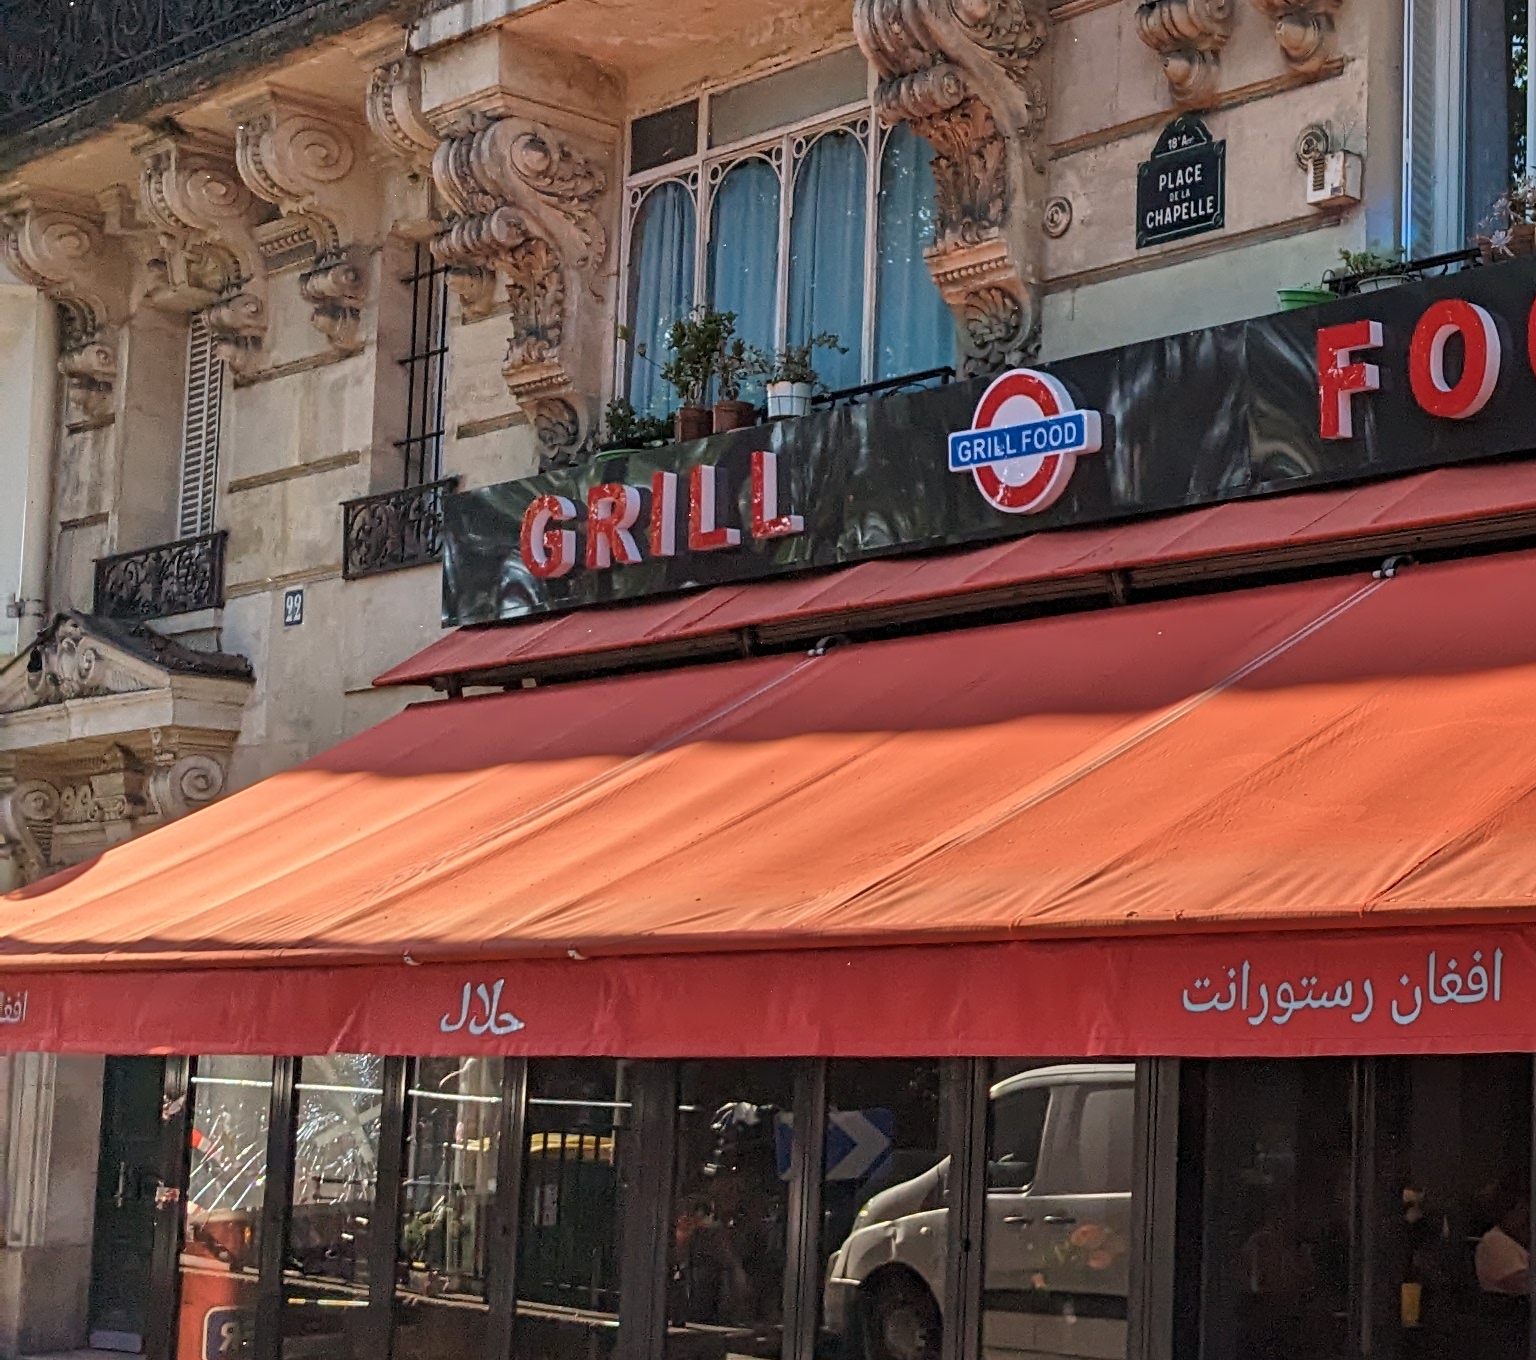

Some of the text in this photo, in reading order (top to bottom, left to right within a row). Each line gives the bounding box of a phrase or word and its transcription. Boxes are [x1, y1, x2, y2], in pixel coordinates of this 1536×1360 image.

[1159, 163, 1203, 192] PLACE
[1169, 188, 1191, 202] DE LA
[1146, 196, 1215, 229] CHAPELLE
[957, 421, 1077, 462] GRILL FOOD
[519, 450, 805, 579] GRILL
[440, 978, 526, 1036] حلال
[1182, 947, 1504, 1026] افغان رستورانت
